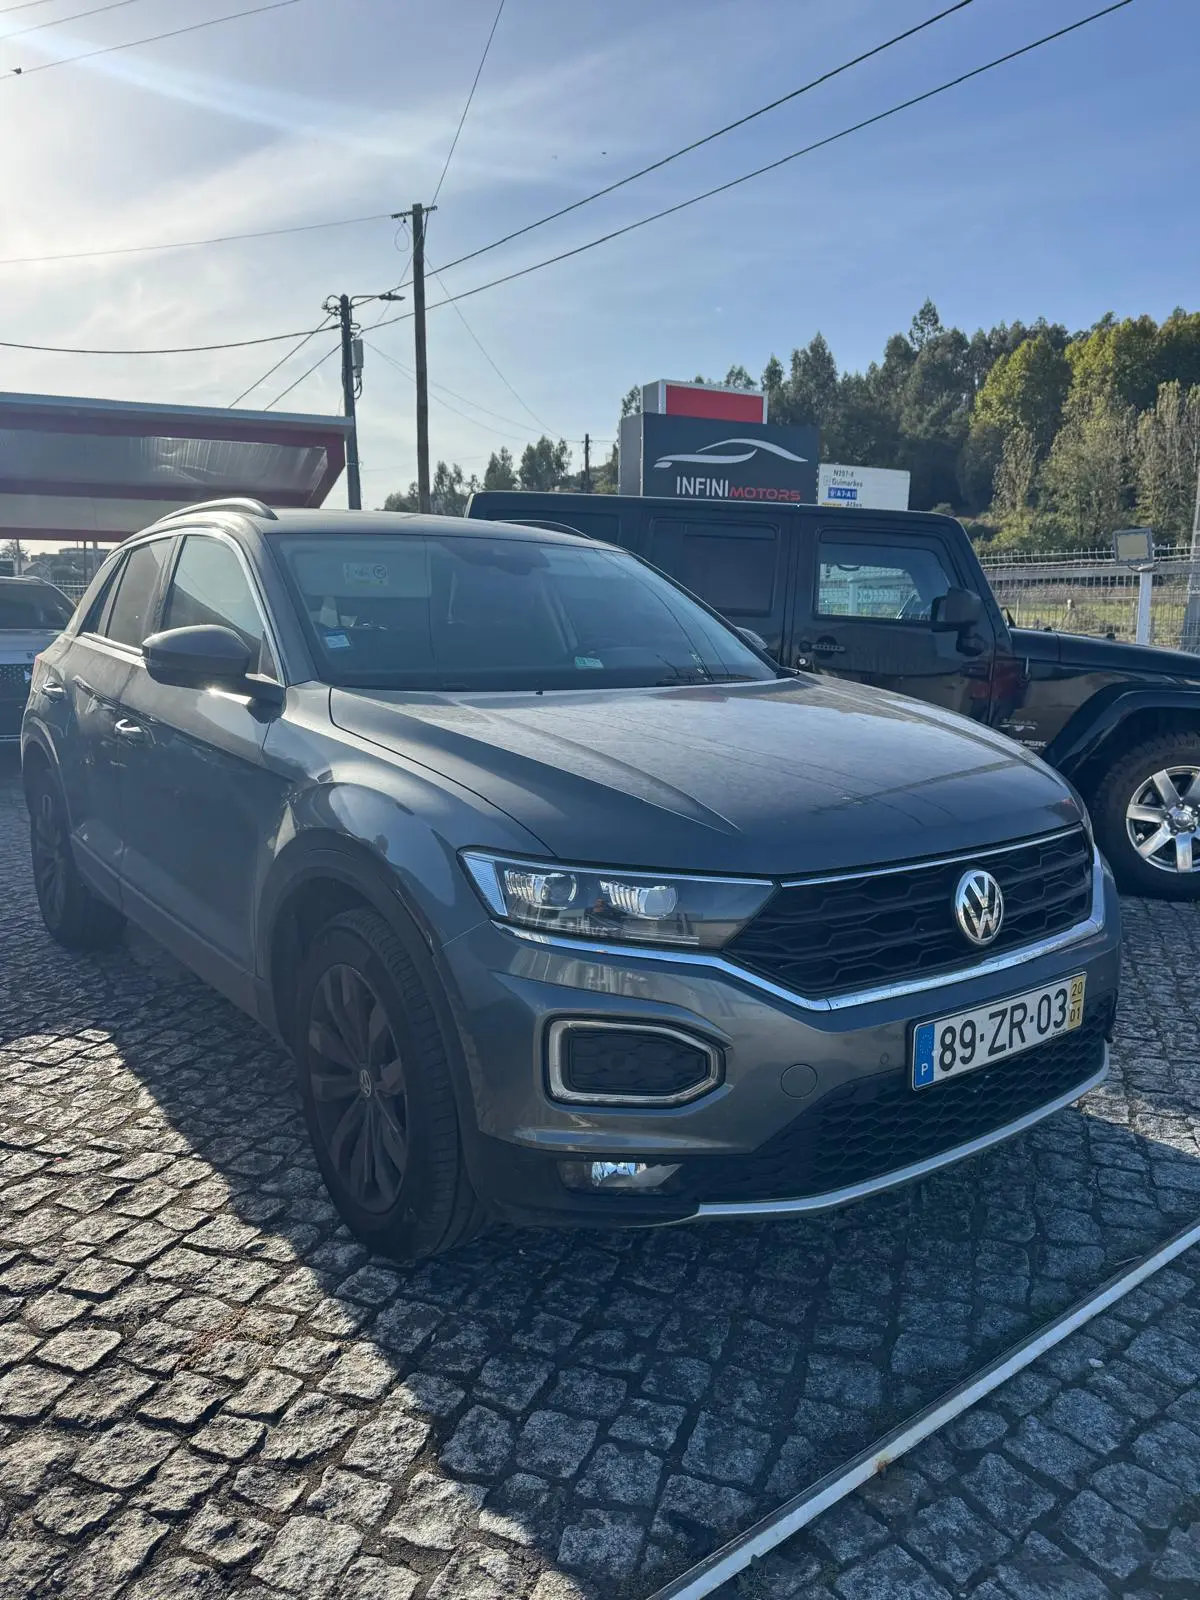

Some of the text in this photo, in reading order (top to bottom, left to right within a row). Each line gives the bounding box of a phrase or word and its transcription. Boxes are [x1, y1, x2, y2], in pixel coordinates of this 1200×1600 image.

[1071, 981, 1083, 997] 20
[1069, 1007, 1081, 1022] 01
[921, 1063, 928, 1076] P
